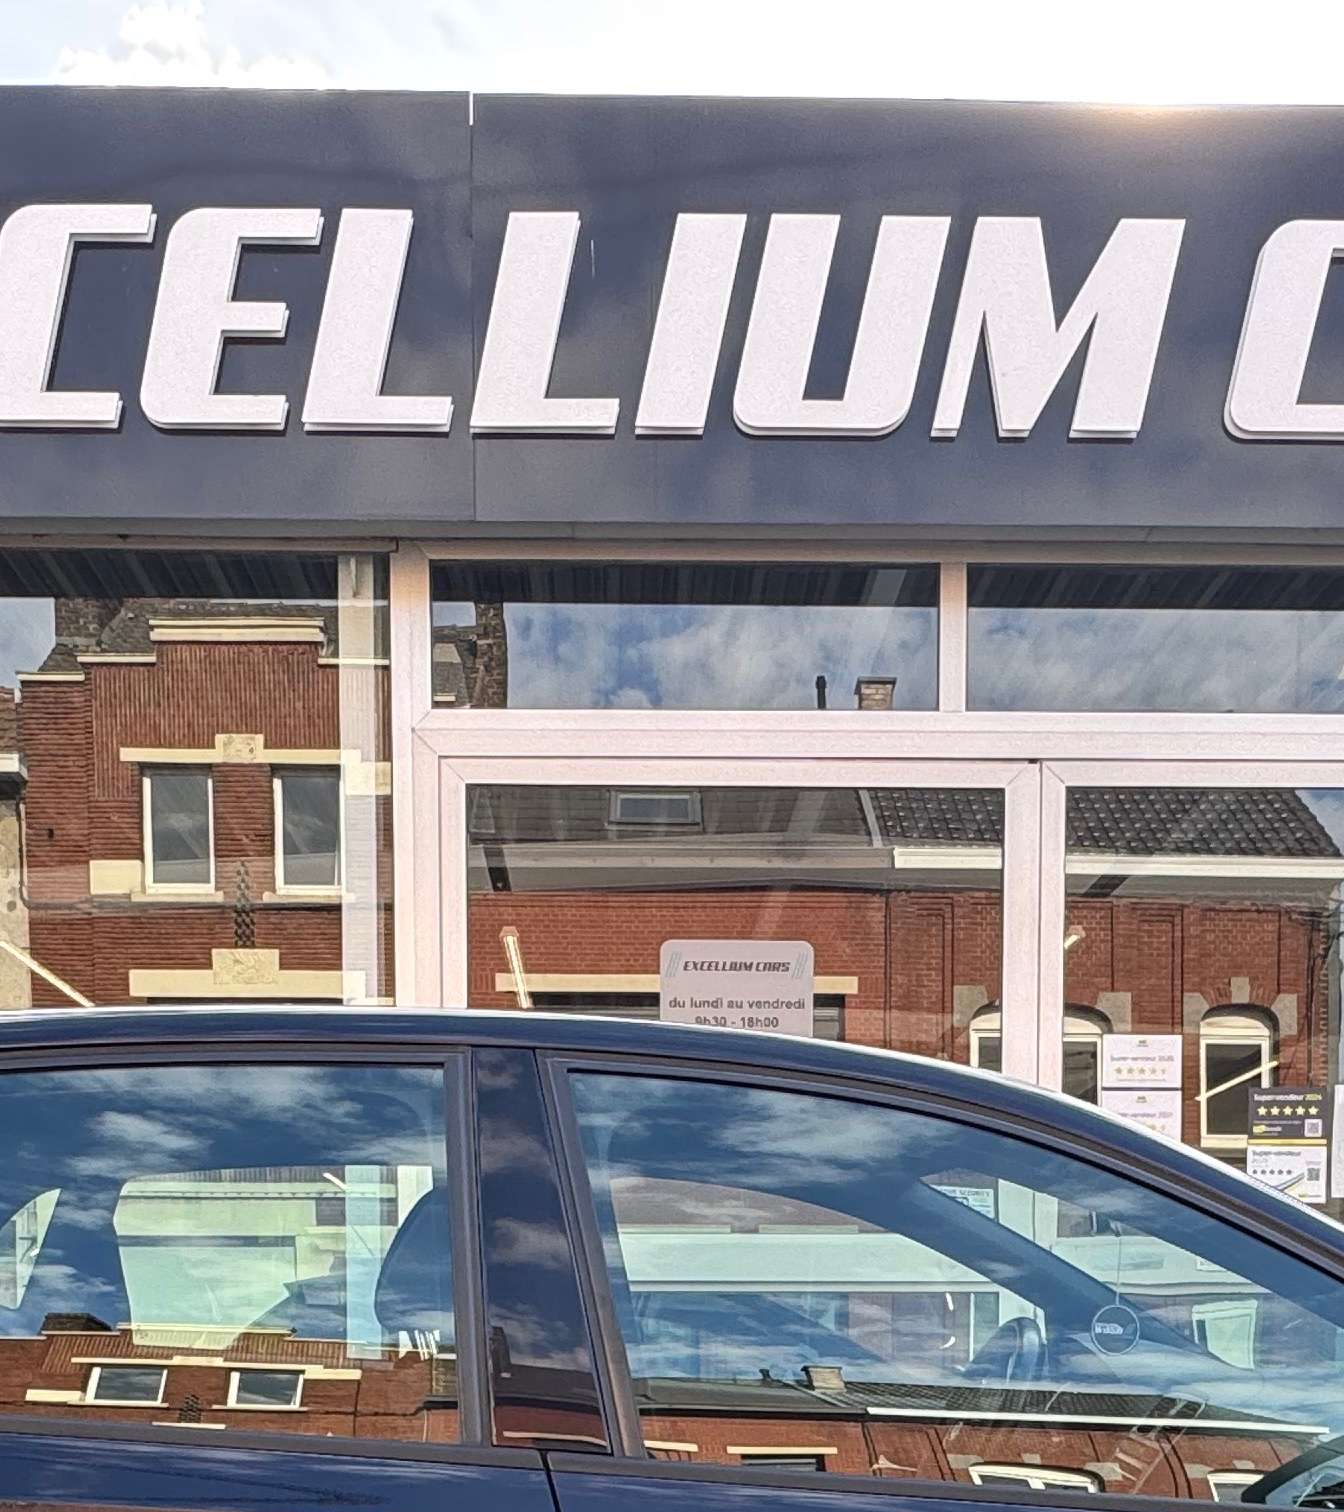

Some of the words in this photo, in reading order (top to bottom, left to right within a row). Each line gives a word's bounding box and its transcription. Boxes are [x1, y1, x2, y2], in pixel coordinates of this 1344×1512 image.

[682, 960, 754, 972] EXCELLIUM
[755, 960, 791, 973] CARS
[669, 997, 686, 1009] du
[690, 997, 723, 1009] lundi
[727, 1000, 744, 1009] au
[748, 998, 806, 1010] vendredi
[740, 1016, 779, 1029] 18h00
